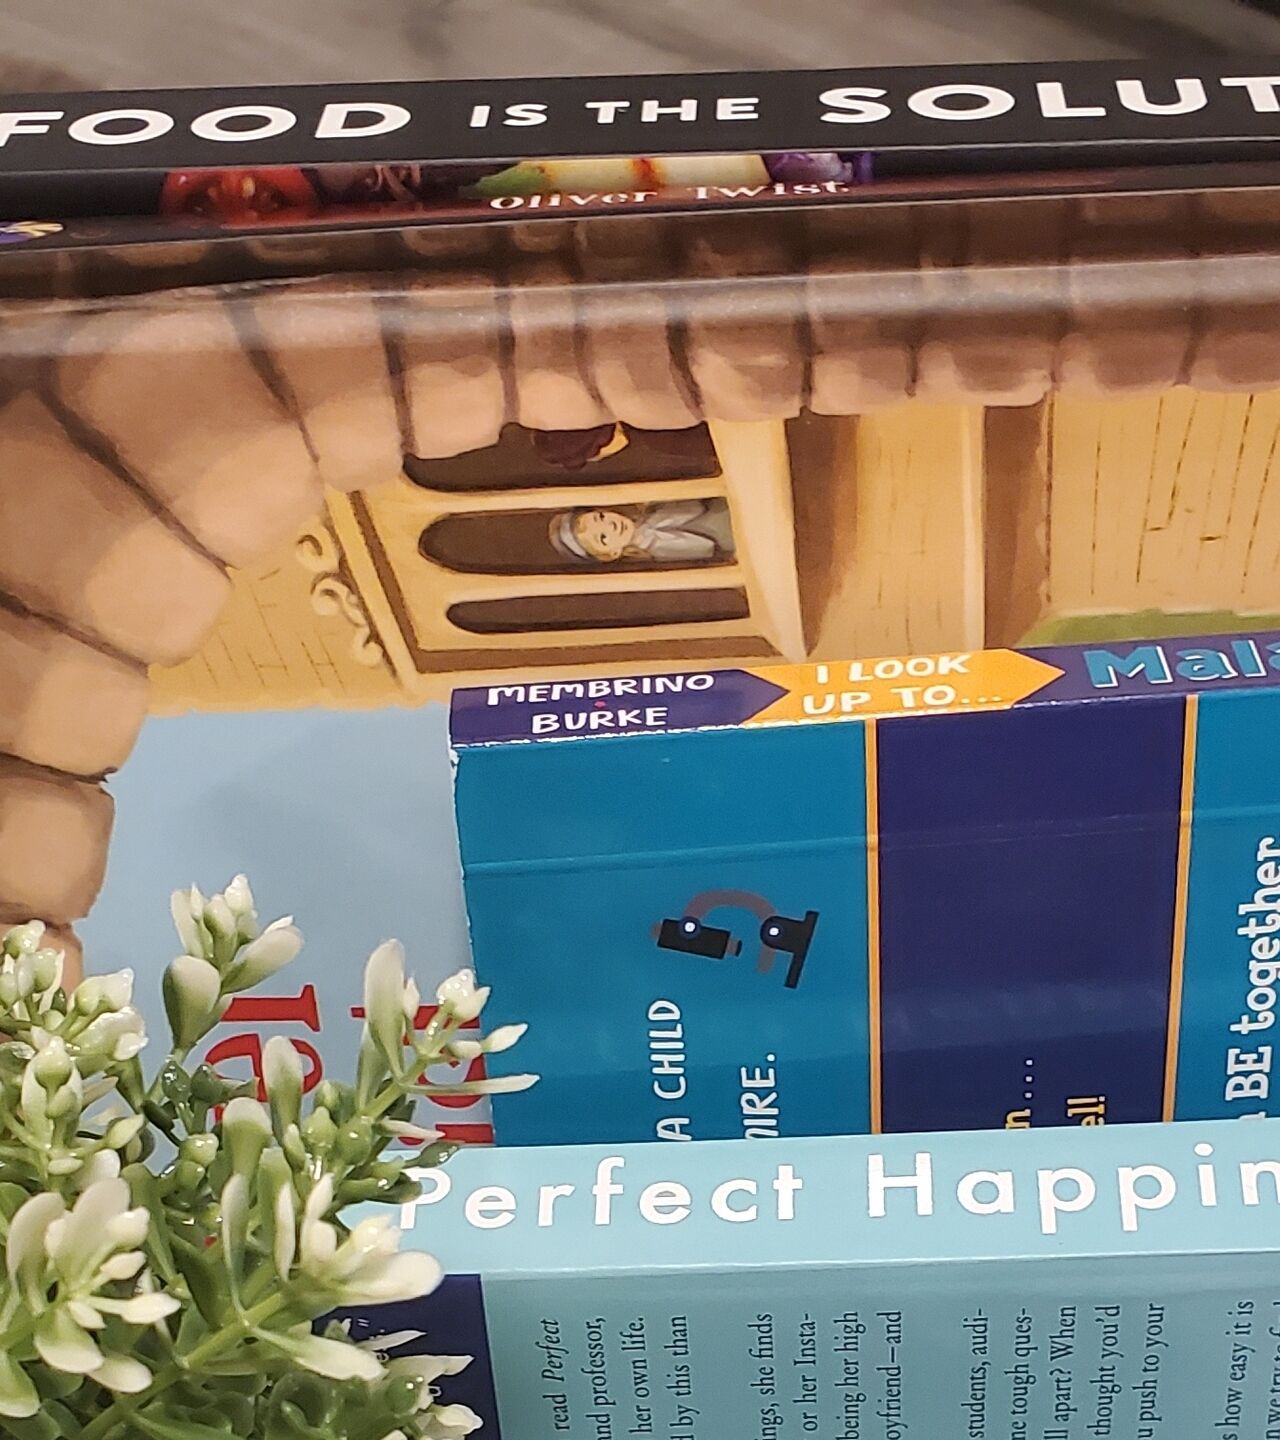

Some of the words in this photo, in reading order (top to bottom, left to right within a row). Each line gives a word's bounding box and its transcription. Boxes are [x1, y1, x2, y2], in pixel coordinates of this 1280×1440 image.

[470, 103, 548, 128] IS
[585, 98, 759, 124] THE
[815, 662, 830, 686] I
[848, 653, 972, 684] LOOK
[487, 672, 716, 706] MEMBRINO
[801, 690, 873, 718] UP
[530, 706, 669, 735] BURKE
[648, 999, 687, 1100] CHILD
[1225, 1046, 1273, 1101] BE
[656, 1117, 692, 1141] A
[400, 1155, 802, 1230] Perfect
[662, 1315, 689, 1356] than
[746, 1313, 774, 1358] finds
[1143, 1302, 1173, 1348] your
[534, 1318, 569, 1382] Perfect
[580, 1317, 616, 1406] professor,
[1141, 1354, 1160, 1372] to
[664, 1364, 691, 1396] this
[749, 1366, 775, 1395] she
[541, 1393, 570, 1430] read
[668, 1403, 700, 1427] by
[959, 1361, 991, 1438] students,
[1131, 1378, 1162, 1422] push
